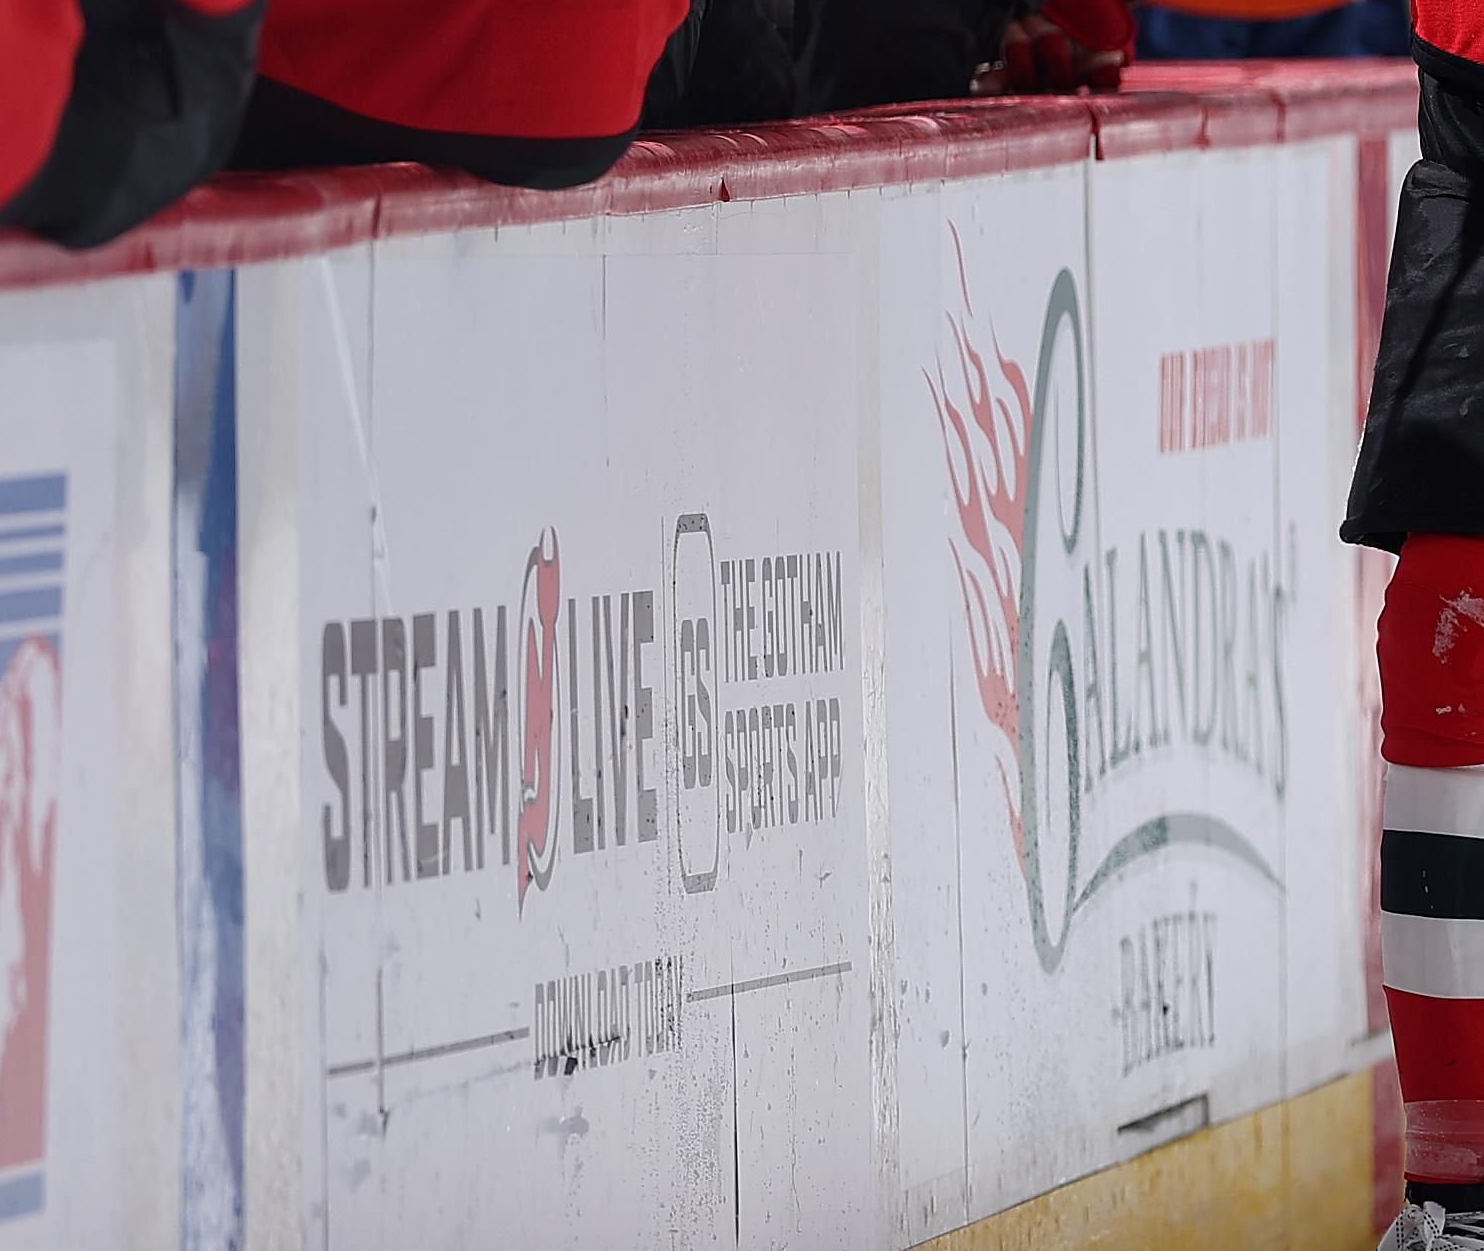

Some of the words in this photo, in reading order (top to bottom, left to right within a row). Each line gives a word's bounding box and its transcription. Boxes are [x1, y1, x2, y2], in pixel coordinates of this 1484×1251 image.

[720, 558, 759, 685] THE
[761, 550, 845, 678] GOTHAM
[322, 605, 511, 895] STREAM
[567, 590, 659, 855] LIVE
[724, 702, 799, 835] SPORTS
[804, 696, 842, 826] APP
[534, 964, 631, 1080] DOWNLOAD
[633, 953, 684, 1058] TODAY
